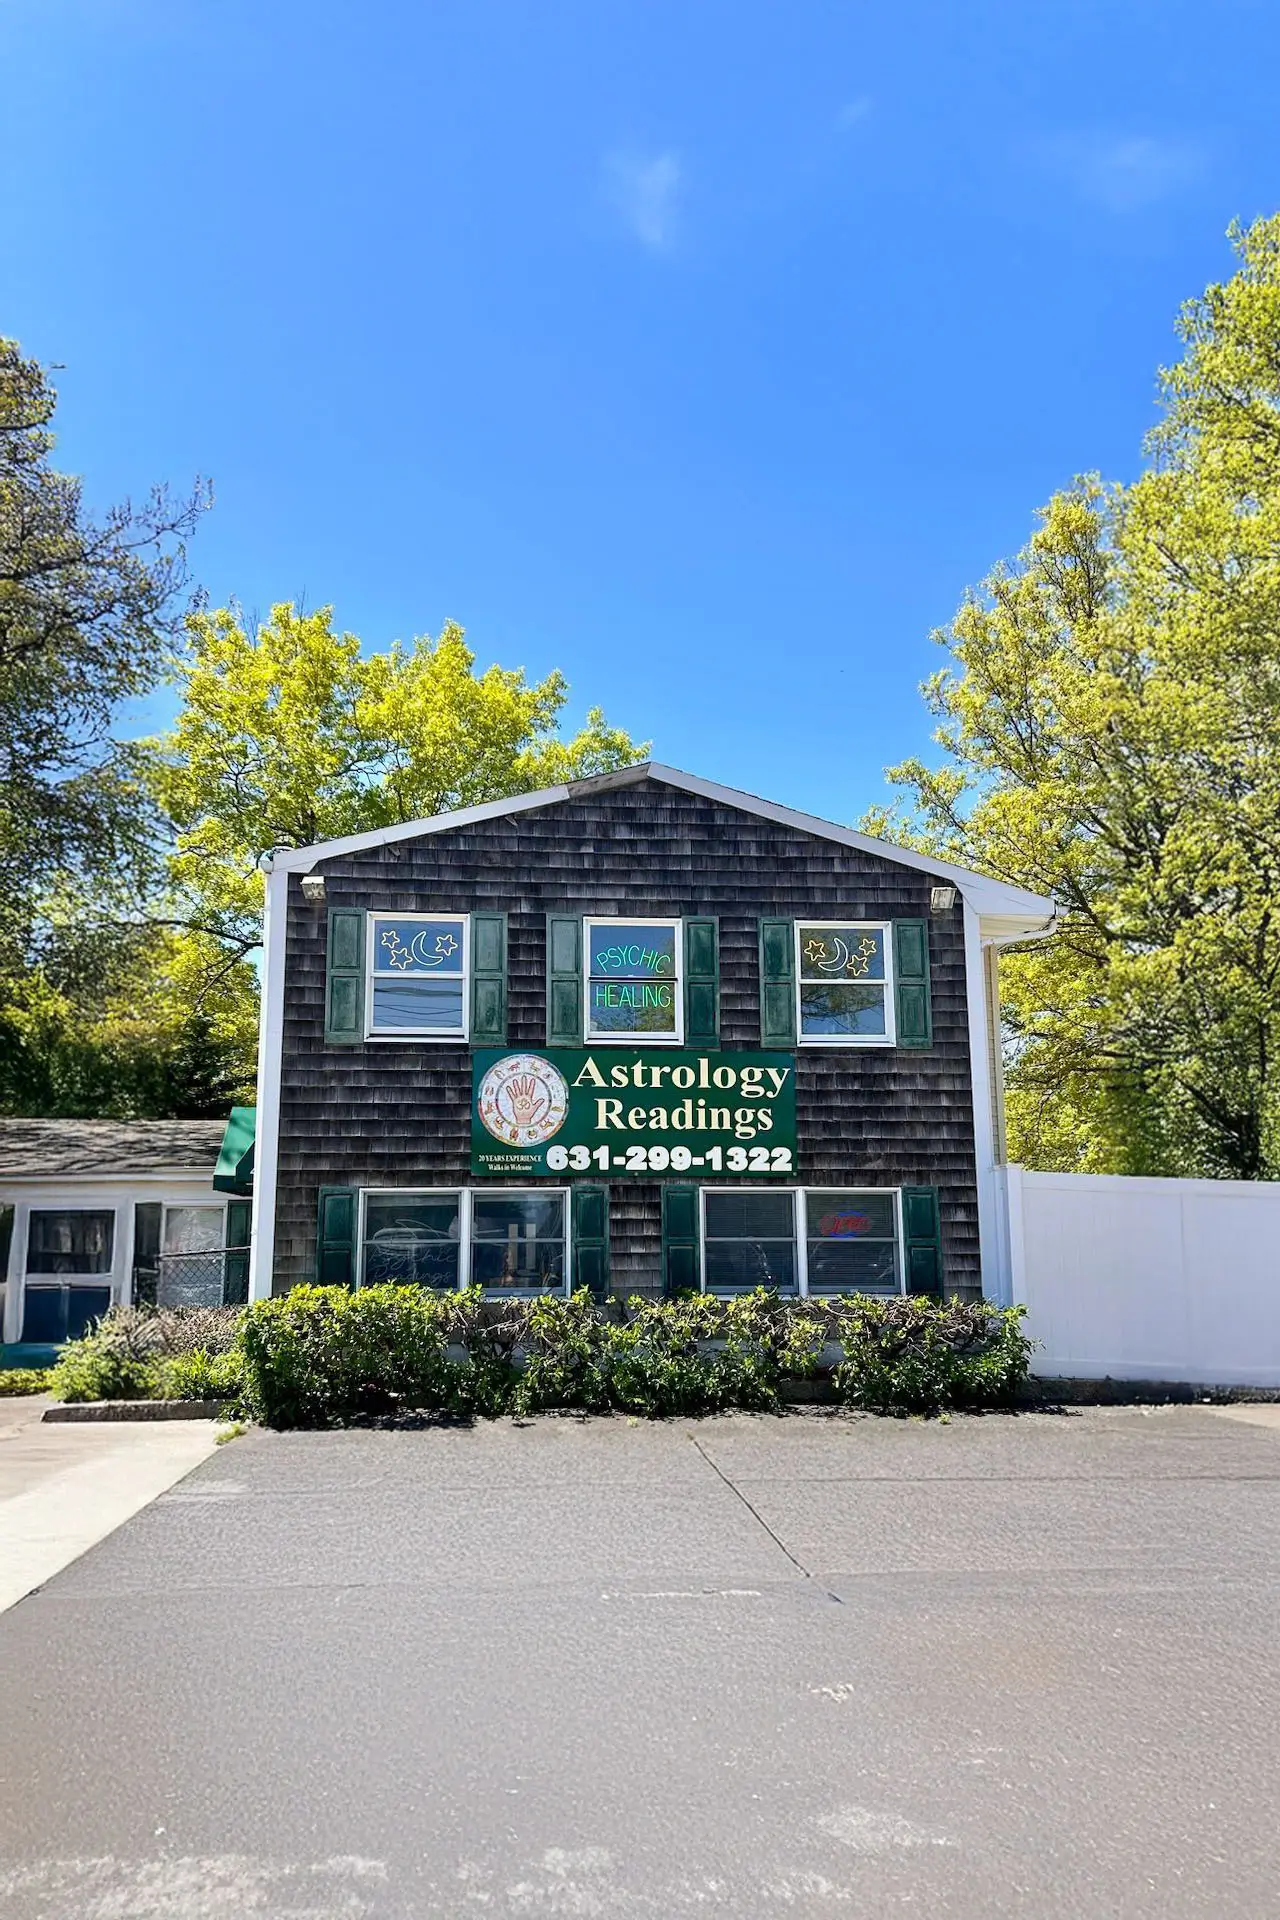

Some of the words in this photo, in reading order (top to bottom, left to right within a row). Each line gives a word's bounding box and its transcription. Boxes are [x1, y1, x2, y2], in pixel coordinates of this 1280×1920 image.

[596, 945, 671, 974] PSYCHIC
[596, 985, 671, 1008] HEALING
[571, 1056, 791, 1098] Astrology
[594, 1098, 774, 1140] Readings
[478, 1154, 486, 1162] 20
[486, 1154, 505, 1162] YEARS
[505, 1154, 543, 1162] EXPERIENCE
[510, 1163, 533, 1171] Welcome
[546, 1145, 793, 1172] 631-299-1322
